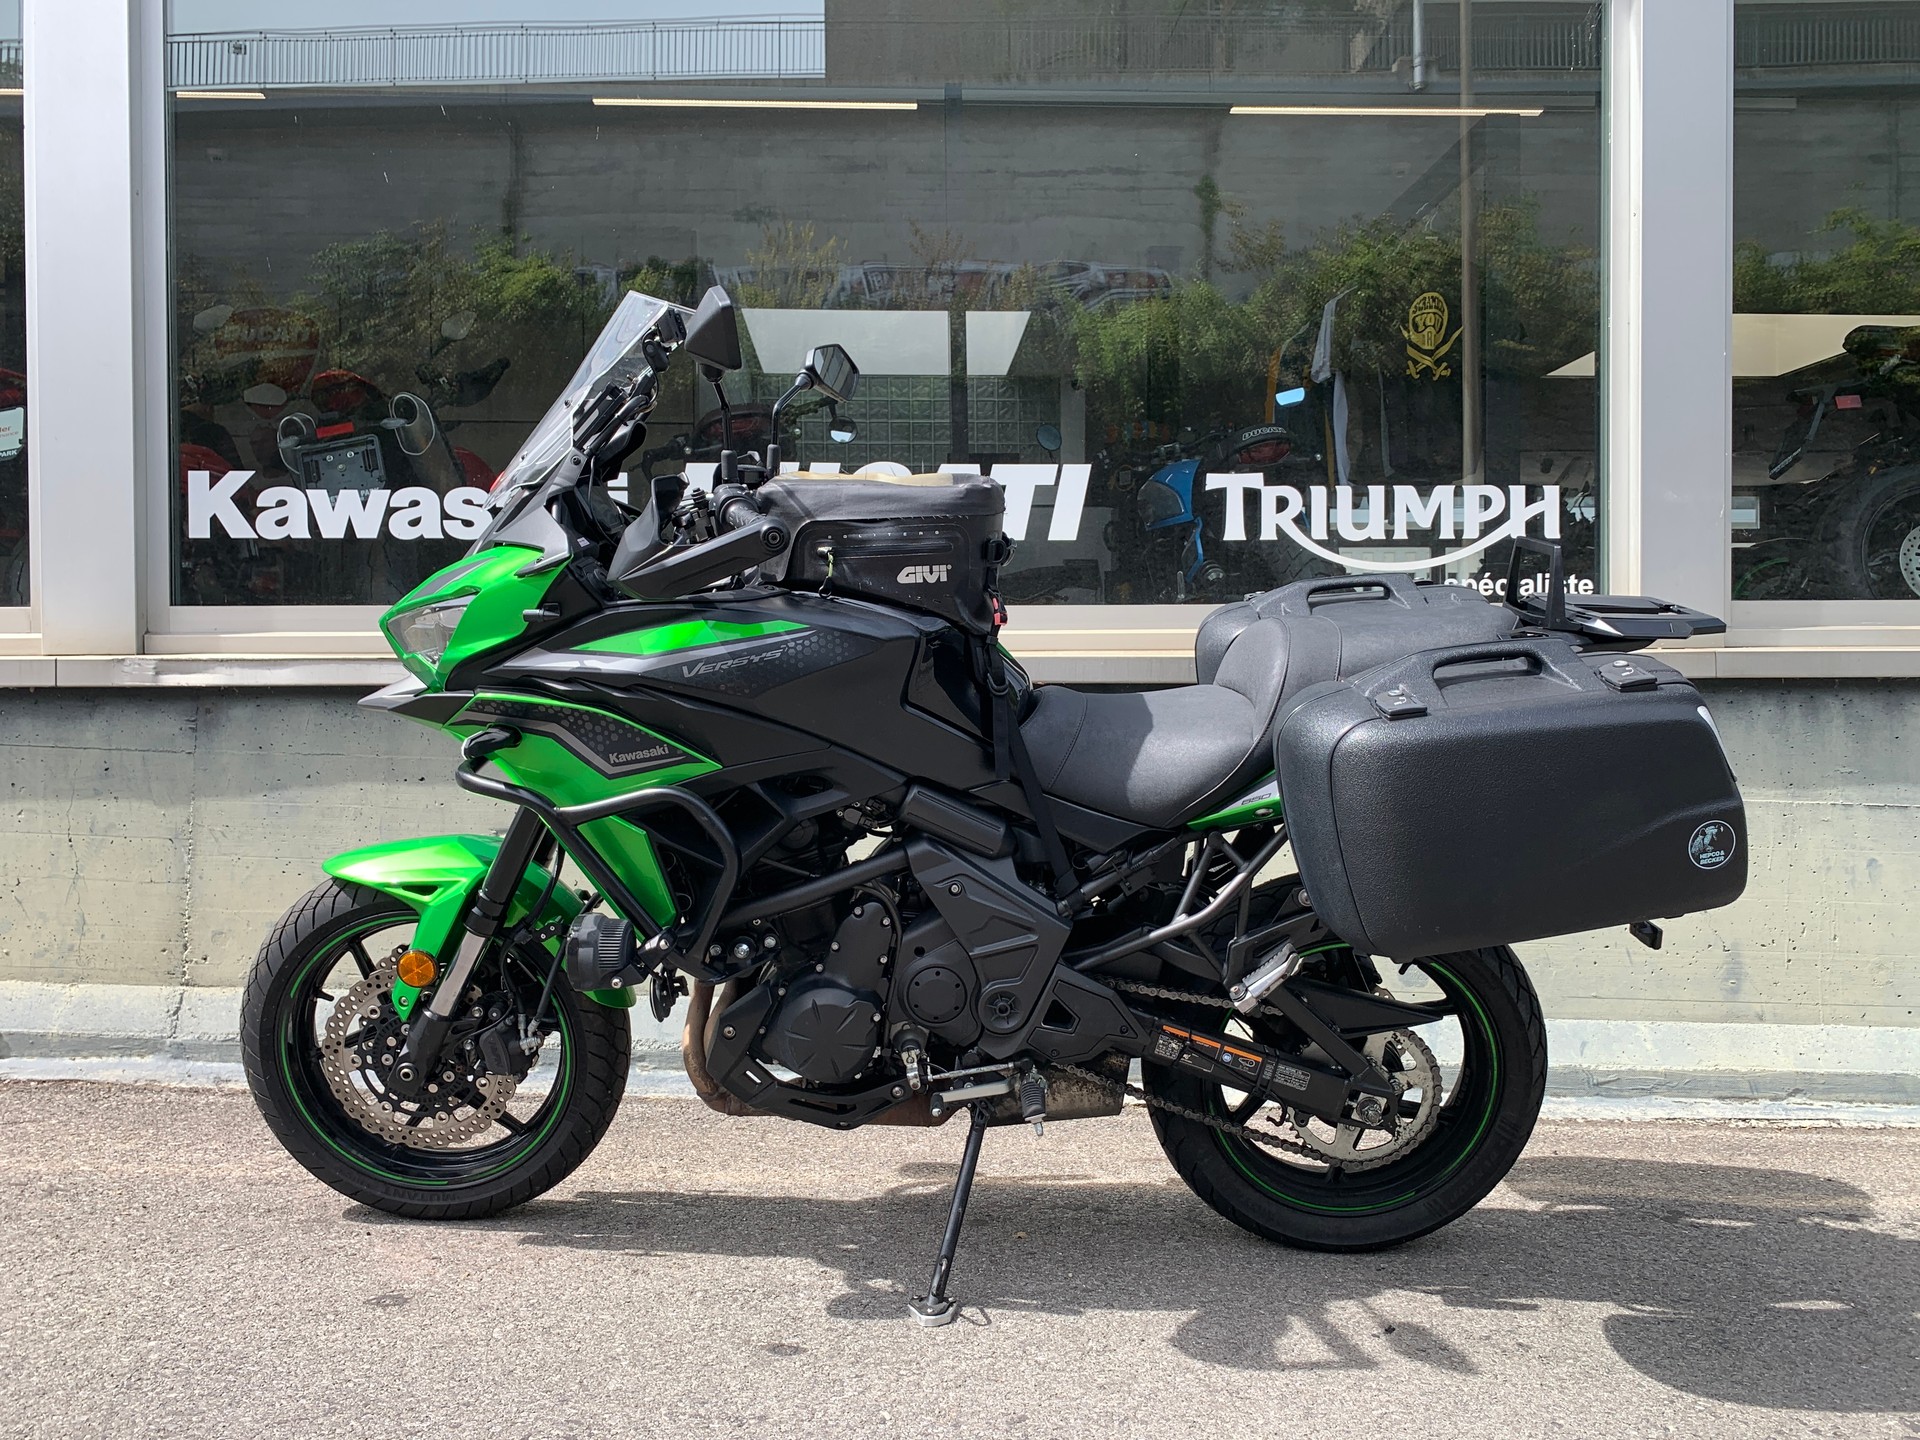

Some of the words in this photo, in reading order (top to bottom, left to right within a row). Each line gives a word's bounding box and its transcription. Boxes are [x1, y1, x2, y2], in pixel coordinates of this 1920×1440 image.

[187, 470, 628, 540] Kawas
[1205, 472, 1561, 571] TRIUMPH
[896, 564, 948, 584] GIVI
[682, 648, 784, 678] VERSYS
[609, 744, 670, 764] Kawasaki
[1700, 851, 1719, 859] HEPCO
[1700, 856, 1725, 865] BECKER
